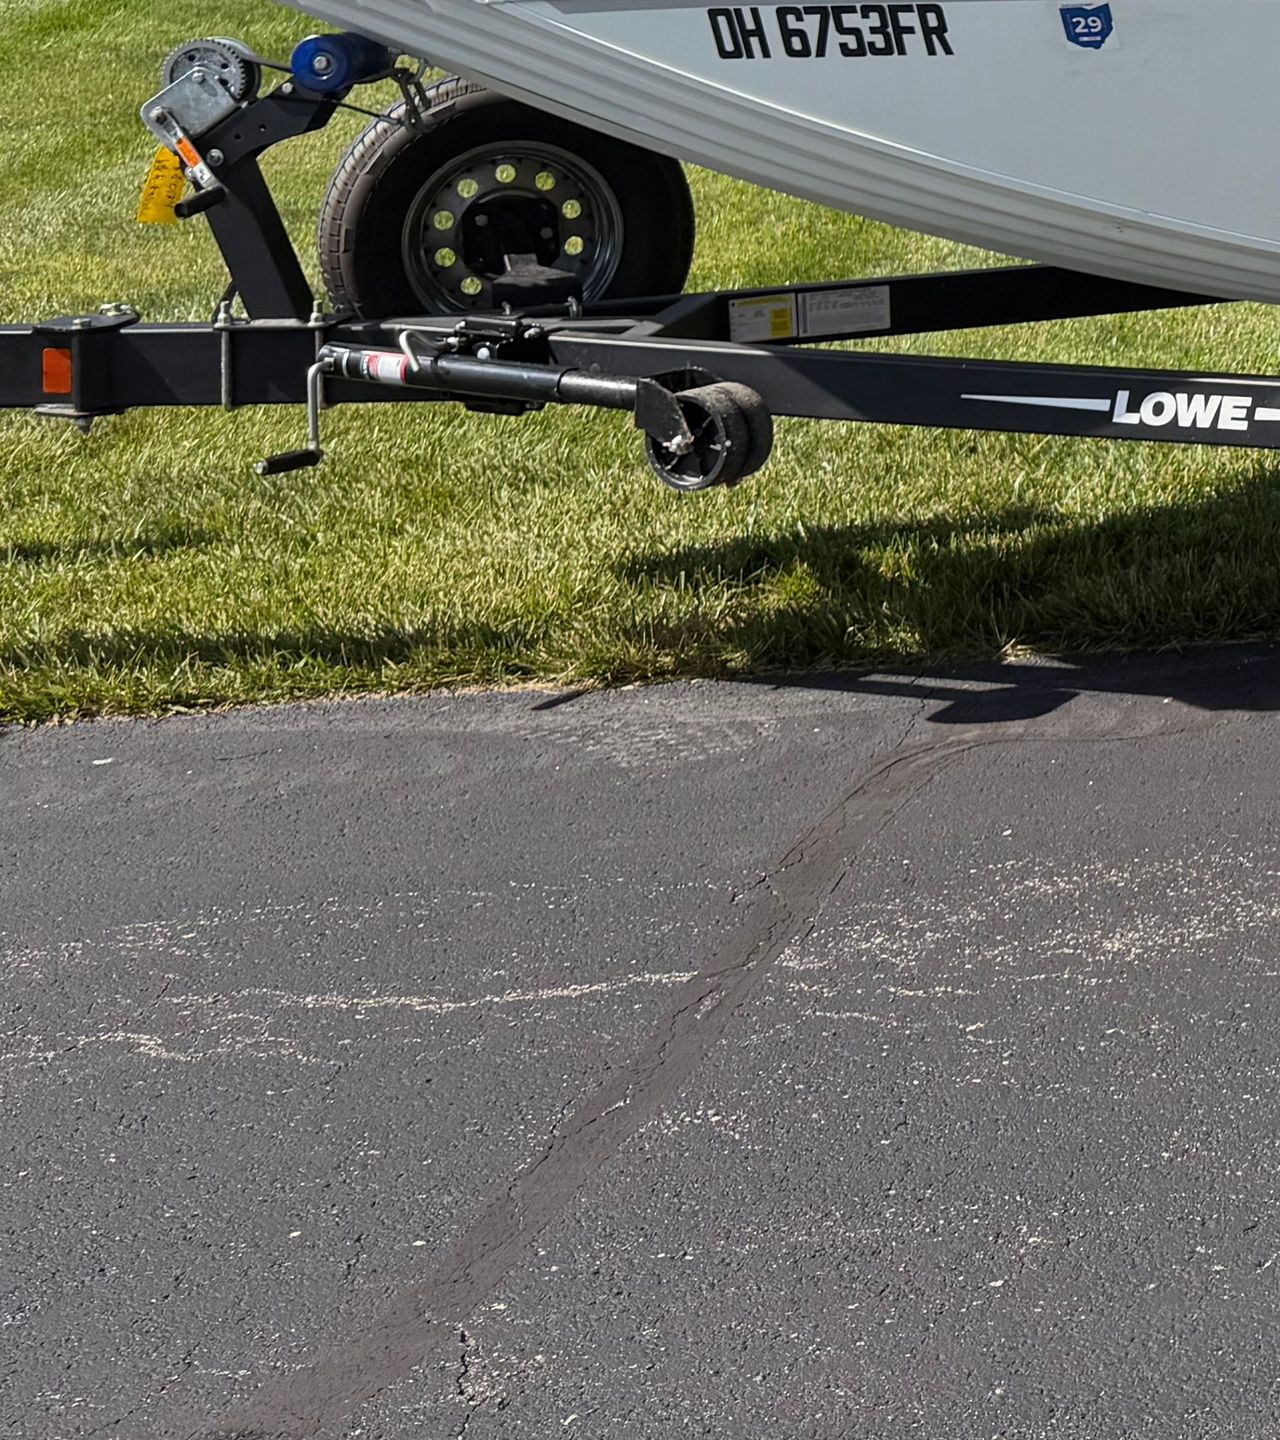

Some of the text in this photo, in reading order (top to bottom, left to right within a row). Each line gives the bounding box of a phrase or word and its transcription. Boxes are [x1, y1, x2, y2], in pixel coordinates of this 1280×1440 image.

[707, 3, 955, 59] OH 6753FR
[1071, 16, 1103, 33] 29
[1111, 389, 1253, 431] LOWE
